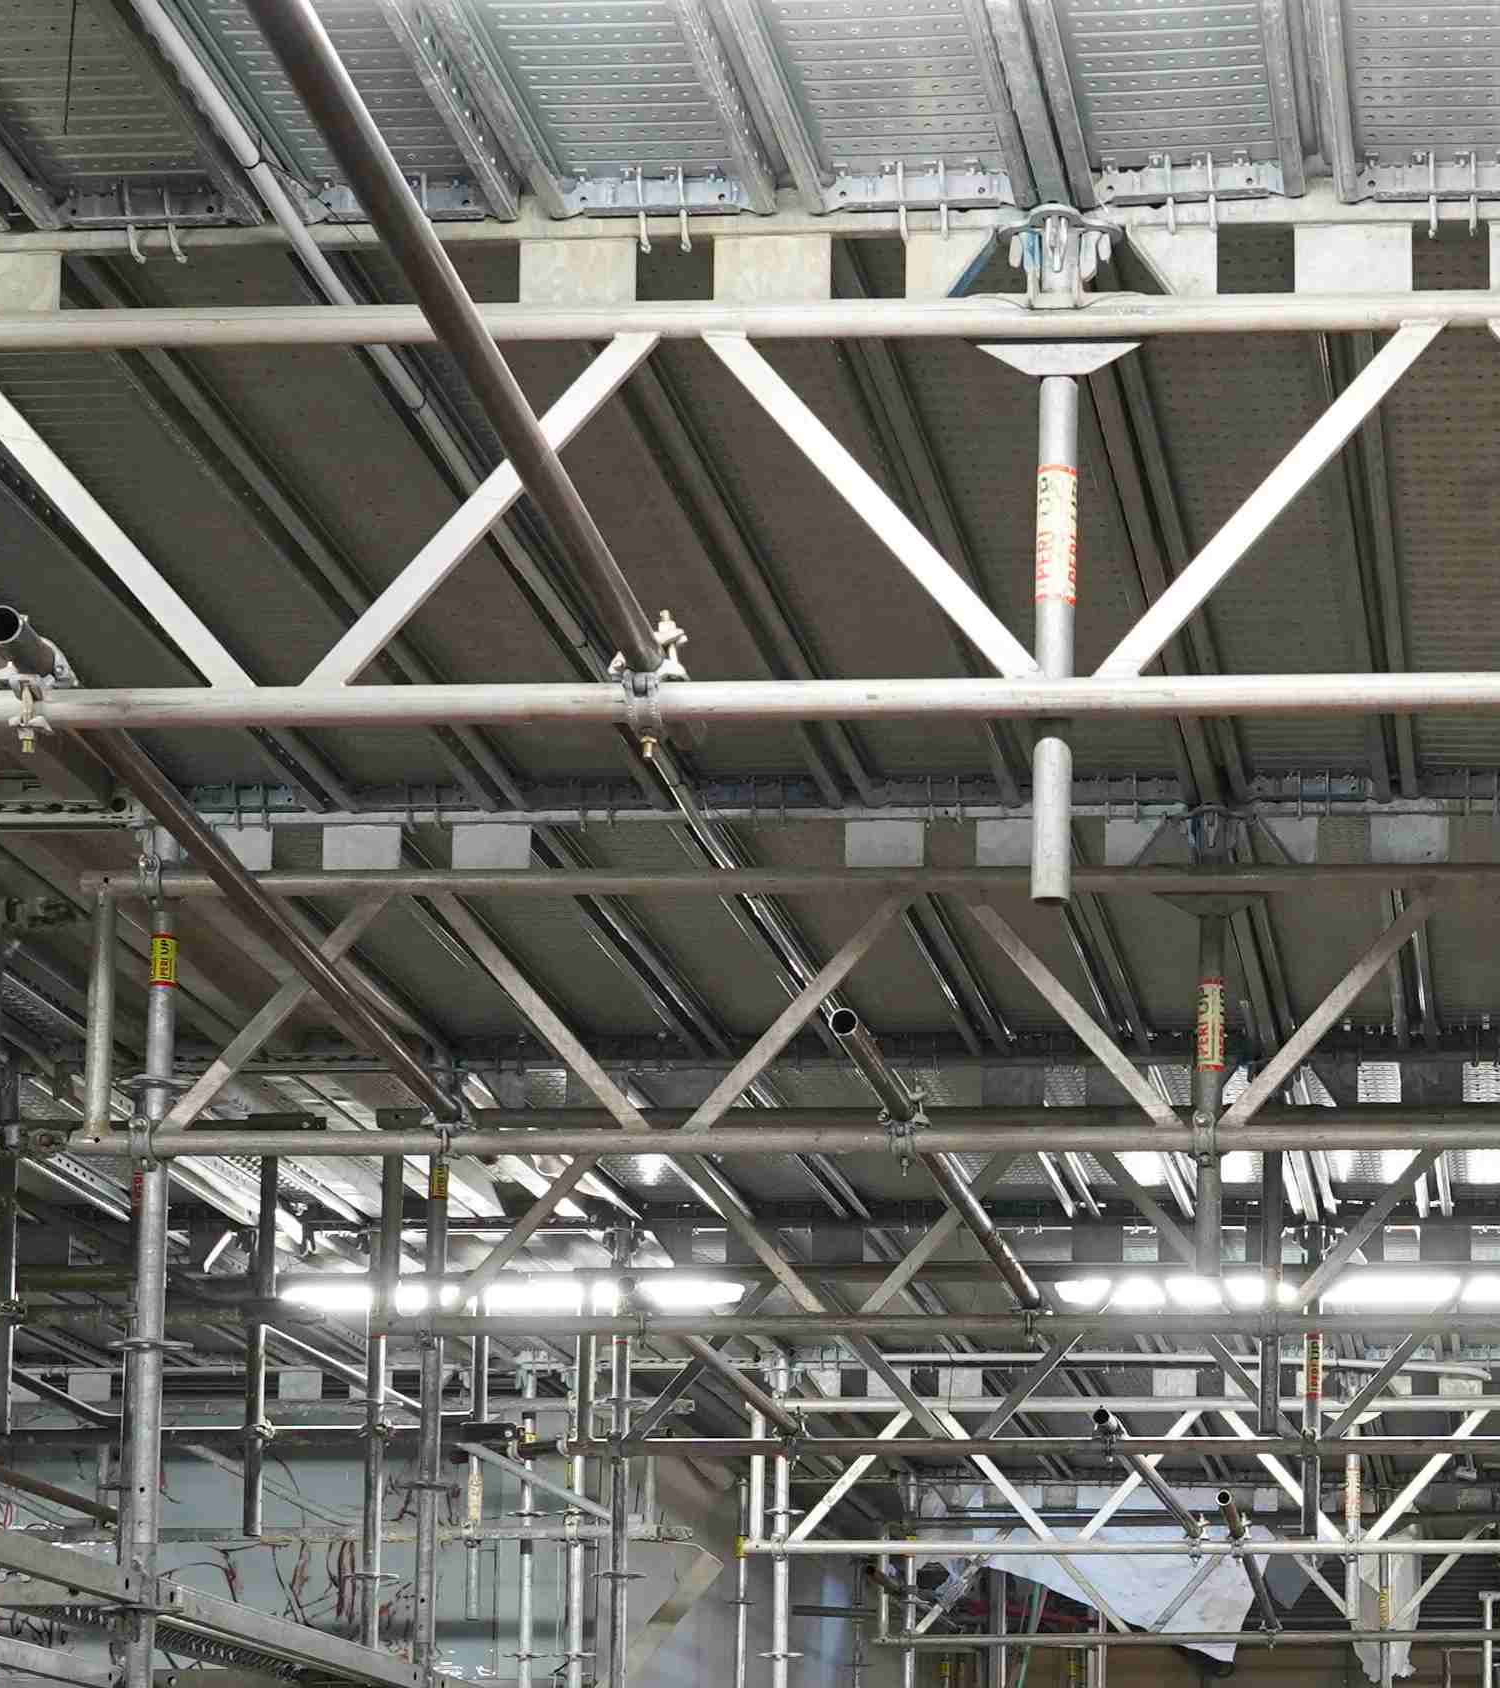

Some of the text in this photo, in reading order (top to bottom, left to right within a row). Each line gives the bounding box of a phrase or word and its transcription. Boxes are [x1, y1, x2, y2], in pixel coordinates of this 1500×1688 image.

[159, 939, 170, 977] PERI UP
[1197, 1023, 1208, 1056] PERI
